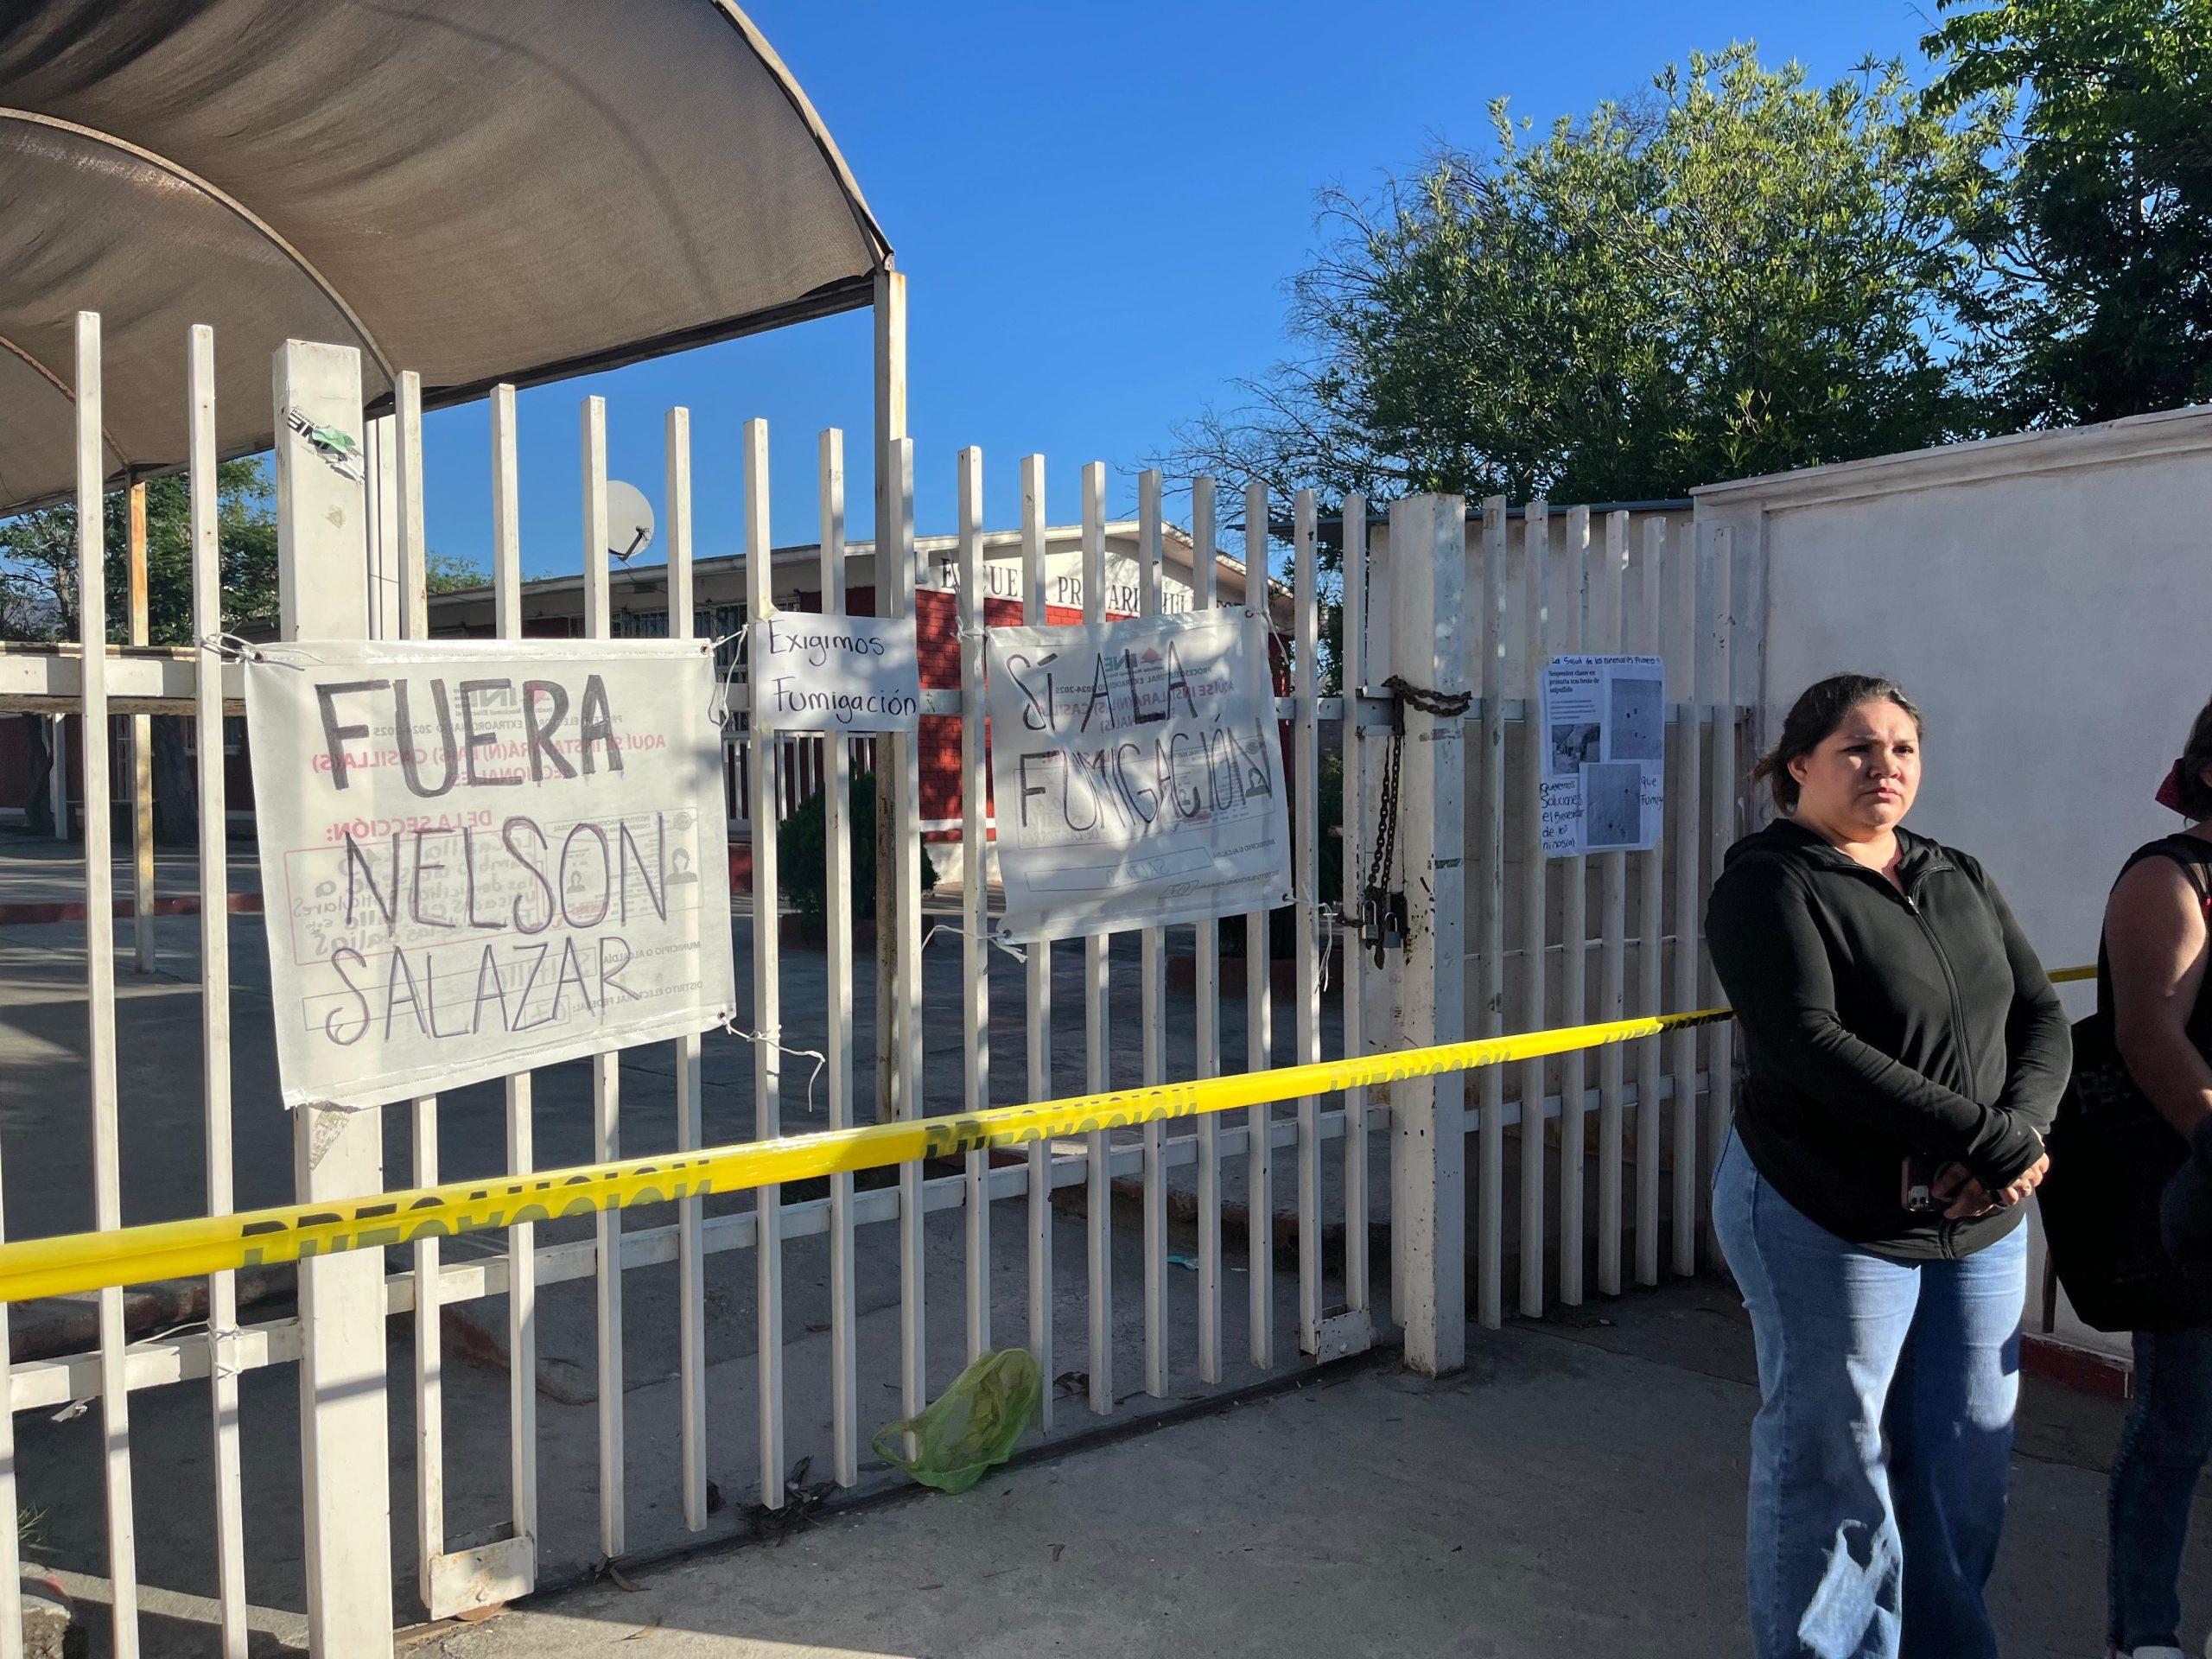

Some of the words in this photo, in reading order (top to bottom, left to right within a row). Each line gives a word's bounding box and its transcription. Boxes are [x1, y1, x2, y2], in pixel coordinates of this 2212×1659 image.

[767, 619, 885, 667] Exigimos
[1080, 652, 1116, 734] A
[1124, 640, 1198, 725] LA
[315, 674, 625, 798] FUERA
[772, 676, 917, 724] Fumigación
[1020, 713, 1274, 832] FUMIGACIÓN
[345, 811, 668, 936] NELSON
[326, 936, 642, 1046] SALAZAR
